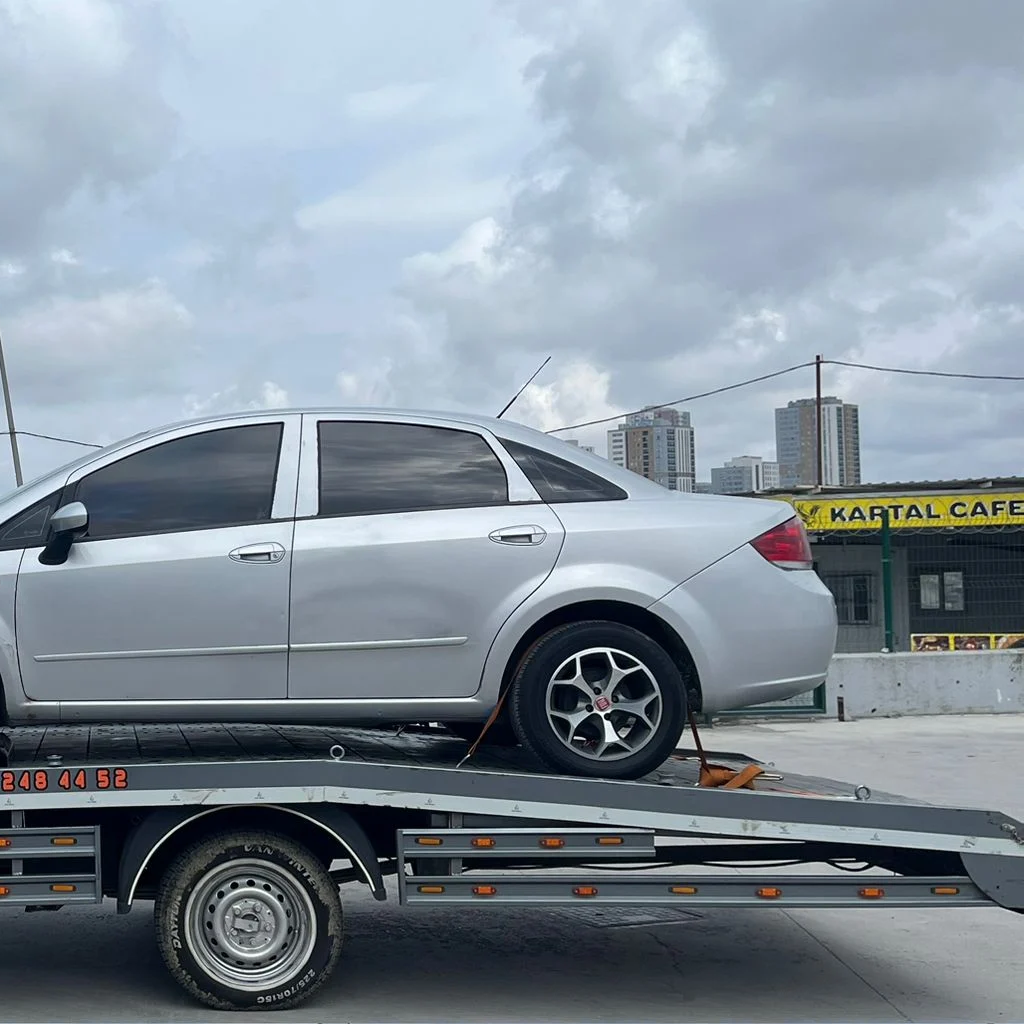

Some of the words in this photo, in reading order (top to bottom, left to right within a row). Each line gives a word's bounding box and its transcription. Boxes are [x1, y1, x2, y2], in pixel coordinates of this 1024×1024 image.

[830, 503, 941, 522] KARTAL
[949, 500, 1024, 518] CAFE
[1, 769, 49, 792] 248
[58, 769, 86, 790] 44
[96, 767, 128, 789] 52
